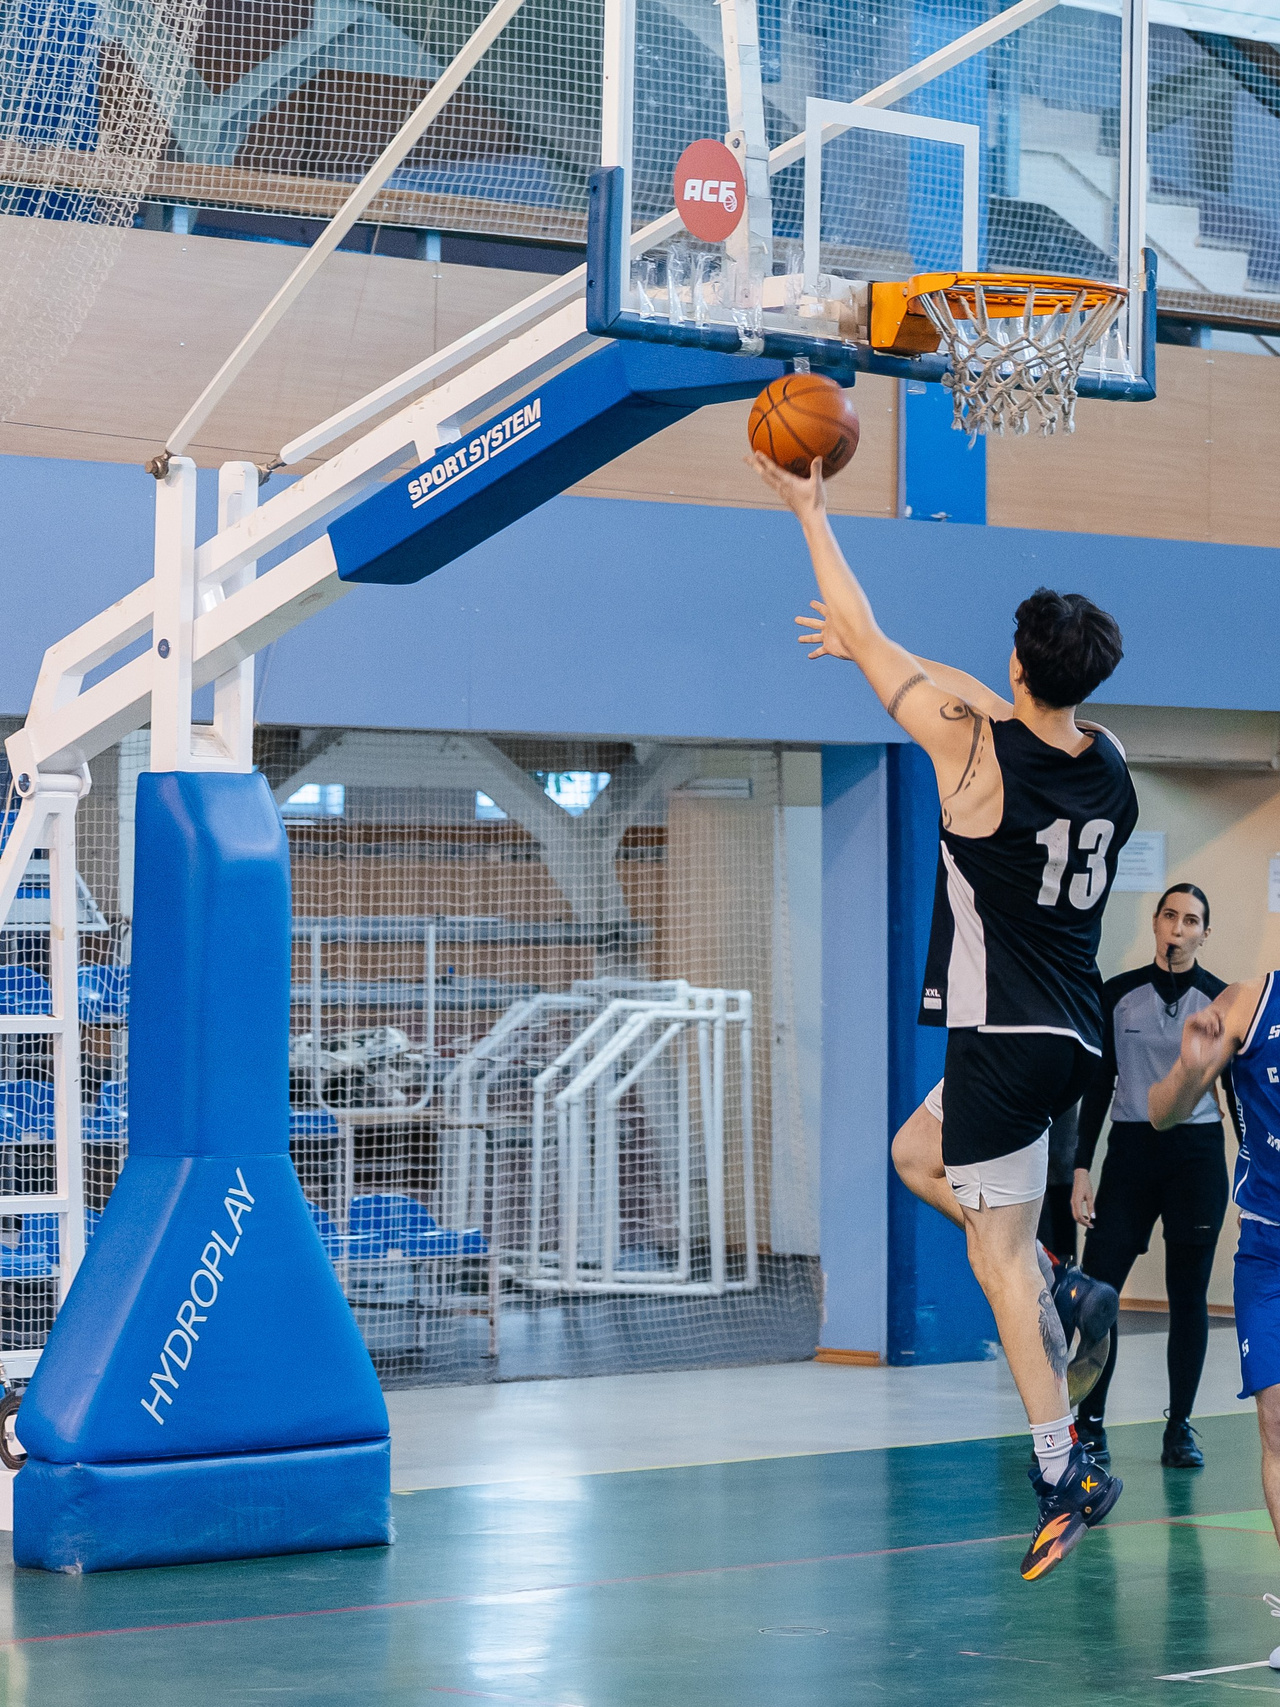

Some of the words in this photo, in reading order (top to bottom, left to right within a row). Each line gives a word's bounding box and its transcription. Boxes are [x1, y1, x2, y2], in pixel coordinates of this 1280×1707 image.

[1036, 818, 1115, 910] 13
[924, 988, 941, 997] XXL
[140, 1167, 255, 1426] HYDROPLAY
